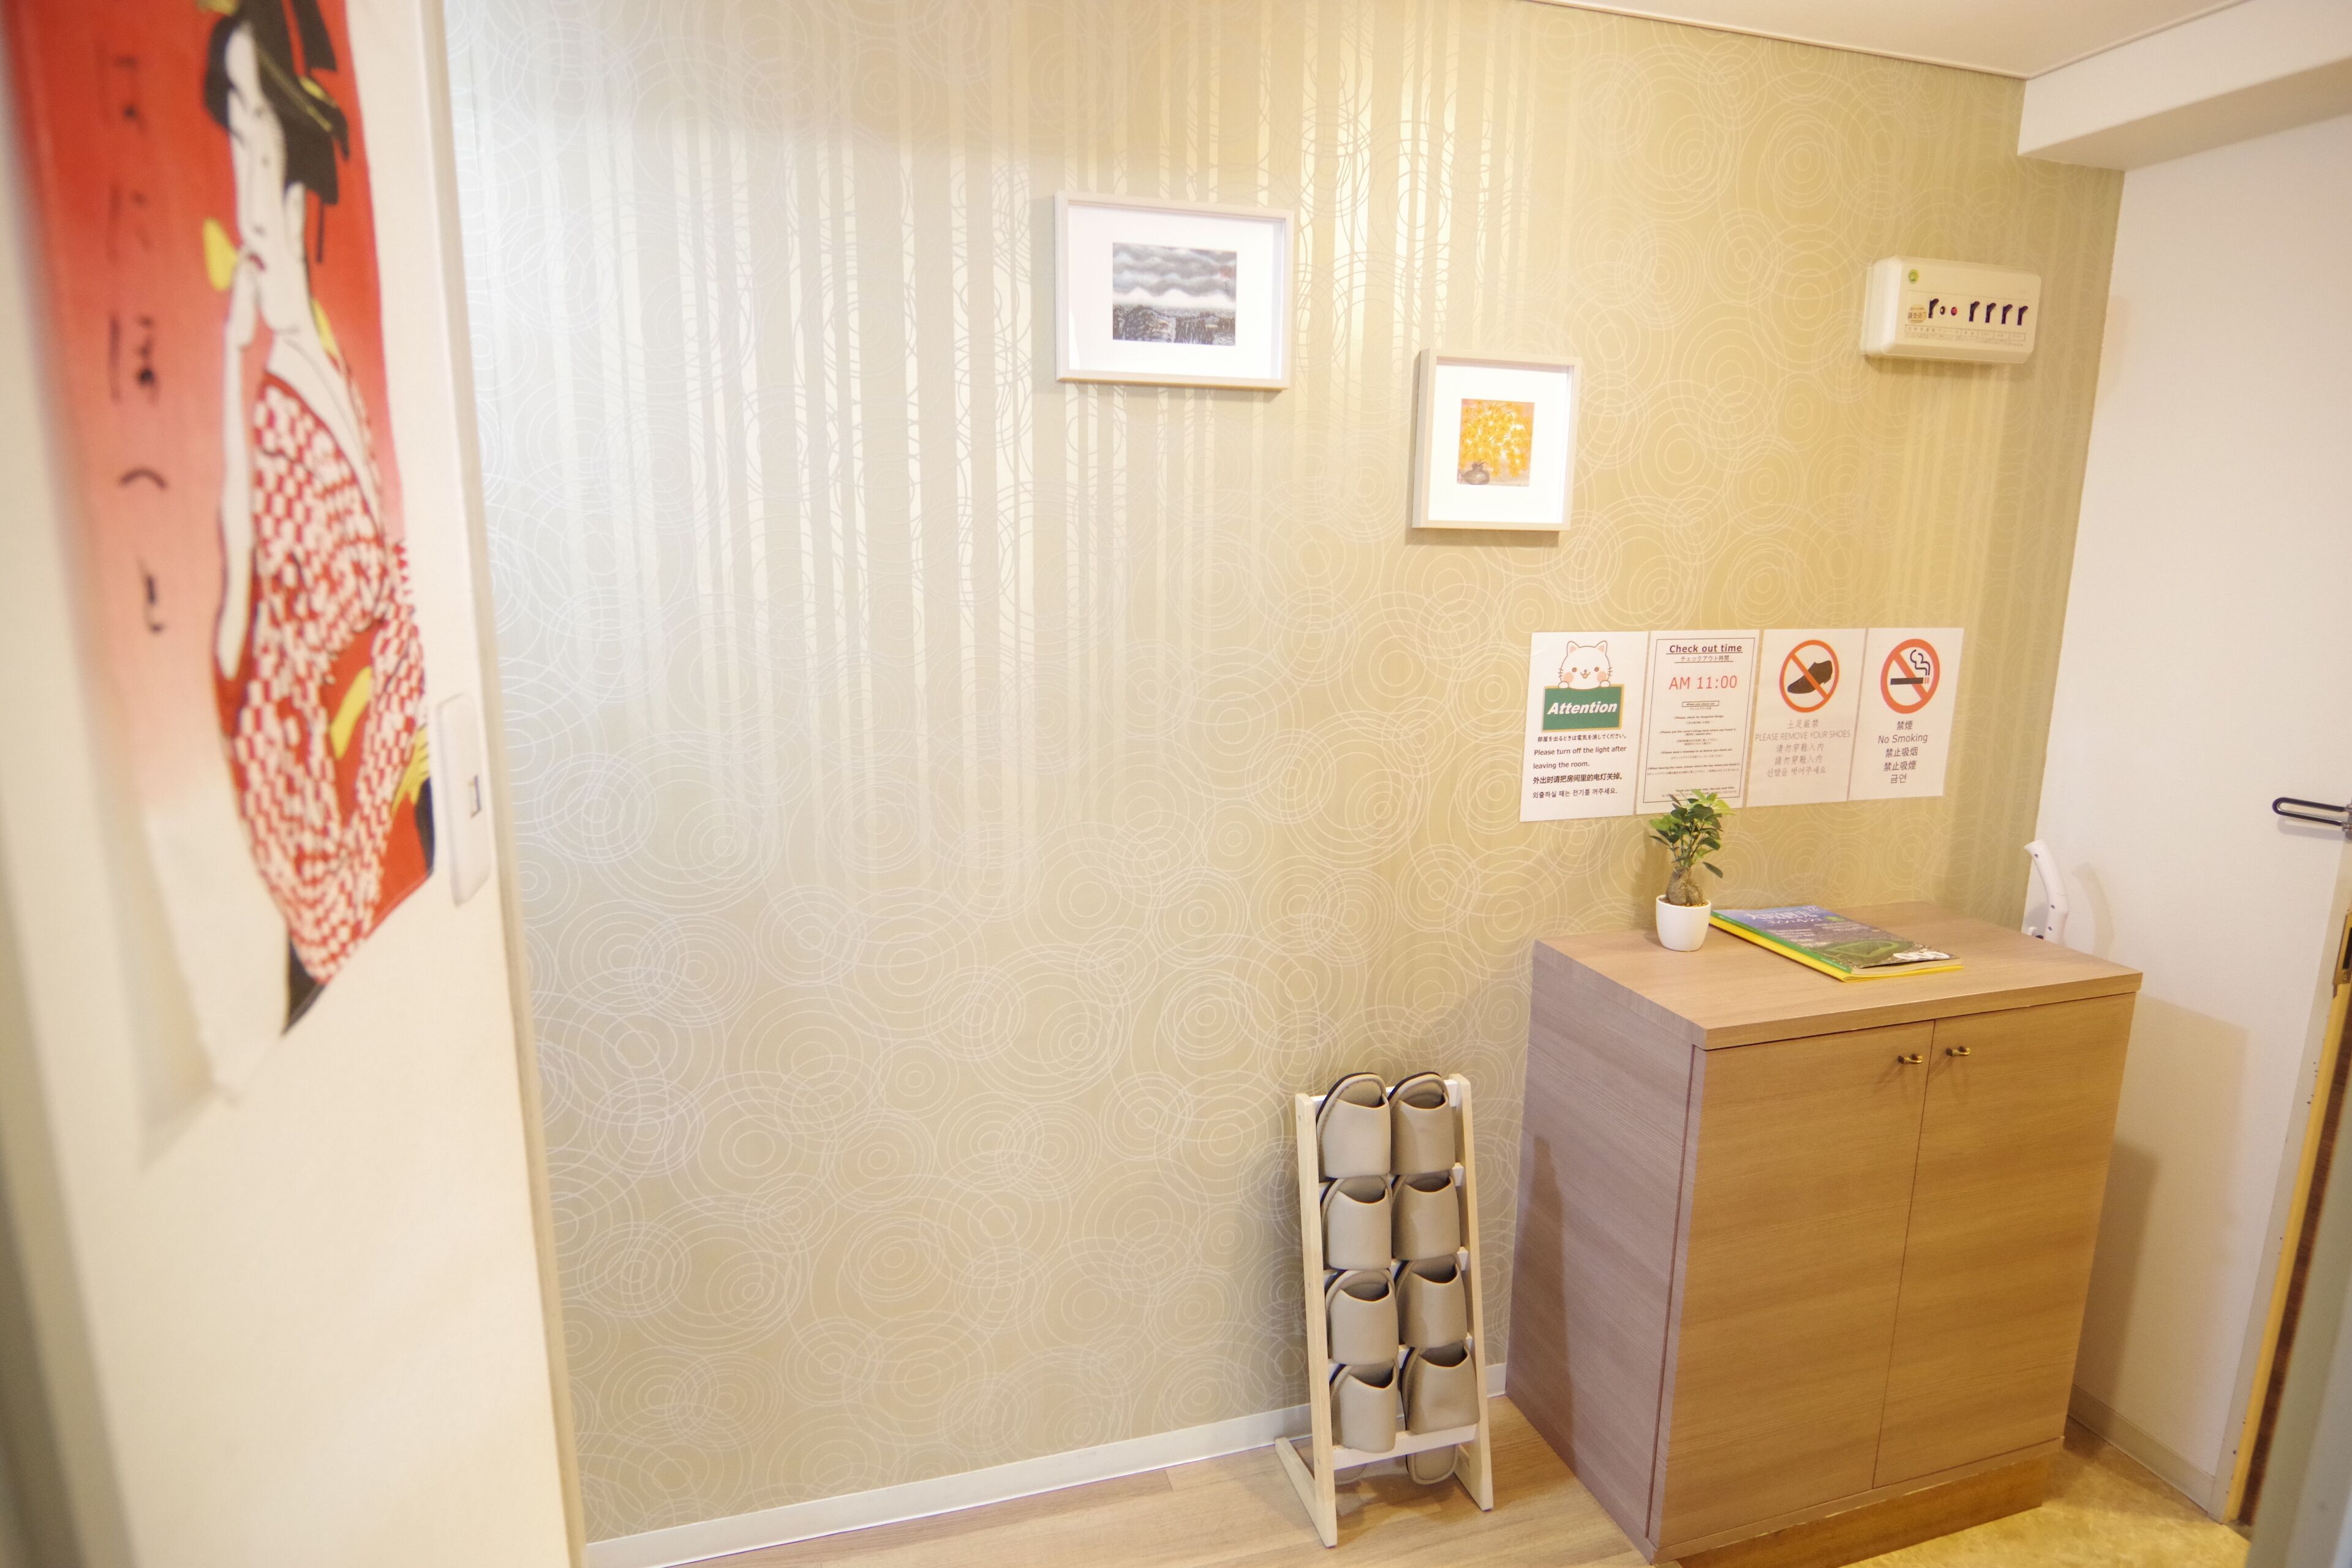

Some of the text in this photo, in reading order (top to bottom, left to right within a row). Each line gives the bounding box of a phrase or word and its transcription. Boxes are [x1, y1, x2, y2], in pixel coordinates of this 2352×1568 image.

[1669, 644, 1698, 653] Check
[1668, 675, 1737, 690] AM 11:00
[1547, 701, 1618, 715] Attention
[1787, 718, 1820, 729] 土足厳禁
[1896, 720, 1913, 731] 禁煙
[1537, 733, 1627, 742] 部屋を出るときは電気を消してください。
[1755, 729, 1851, 741] PLEASE REMOVE YOUR SHOES
[1878, 733, 1928, 744] No Smoking
[1776, 741, 1825, 753] 请勿穿鞋入内
[1885, 747, 1918, 758] 禁止吸烟
[1883, 760, 1917, 772] 禁止吸煙
[1766, 766, 1826, 778] 신발을 벗어주세요
[1532, 772, 1623, 785] 外出时请把房间里的电灯关掉。
[1890, 773, 1907, 784] 금연
[1592, 787, 1618, 796] 꺼주세요.
